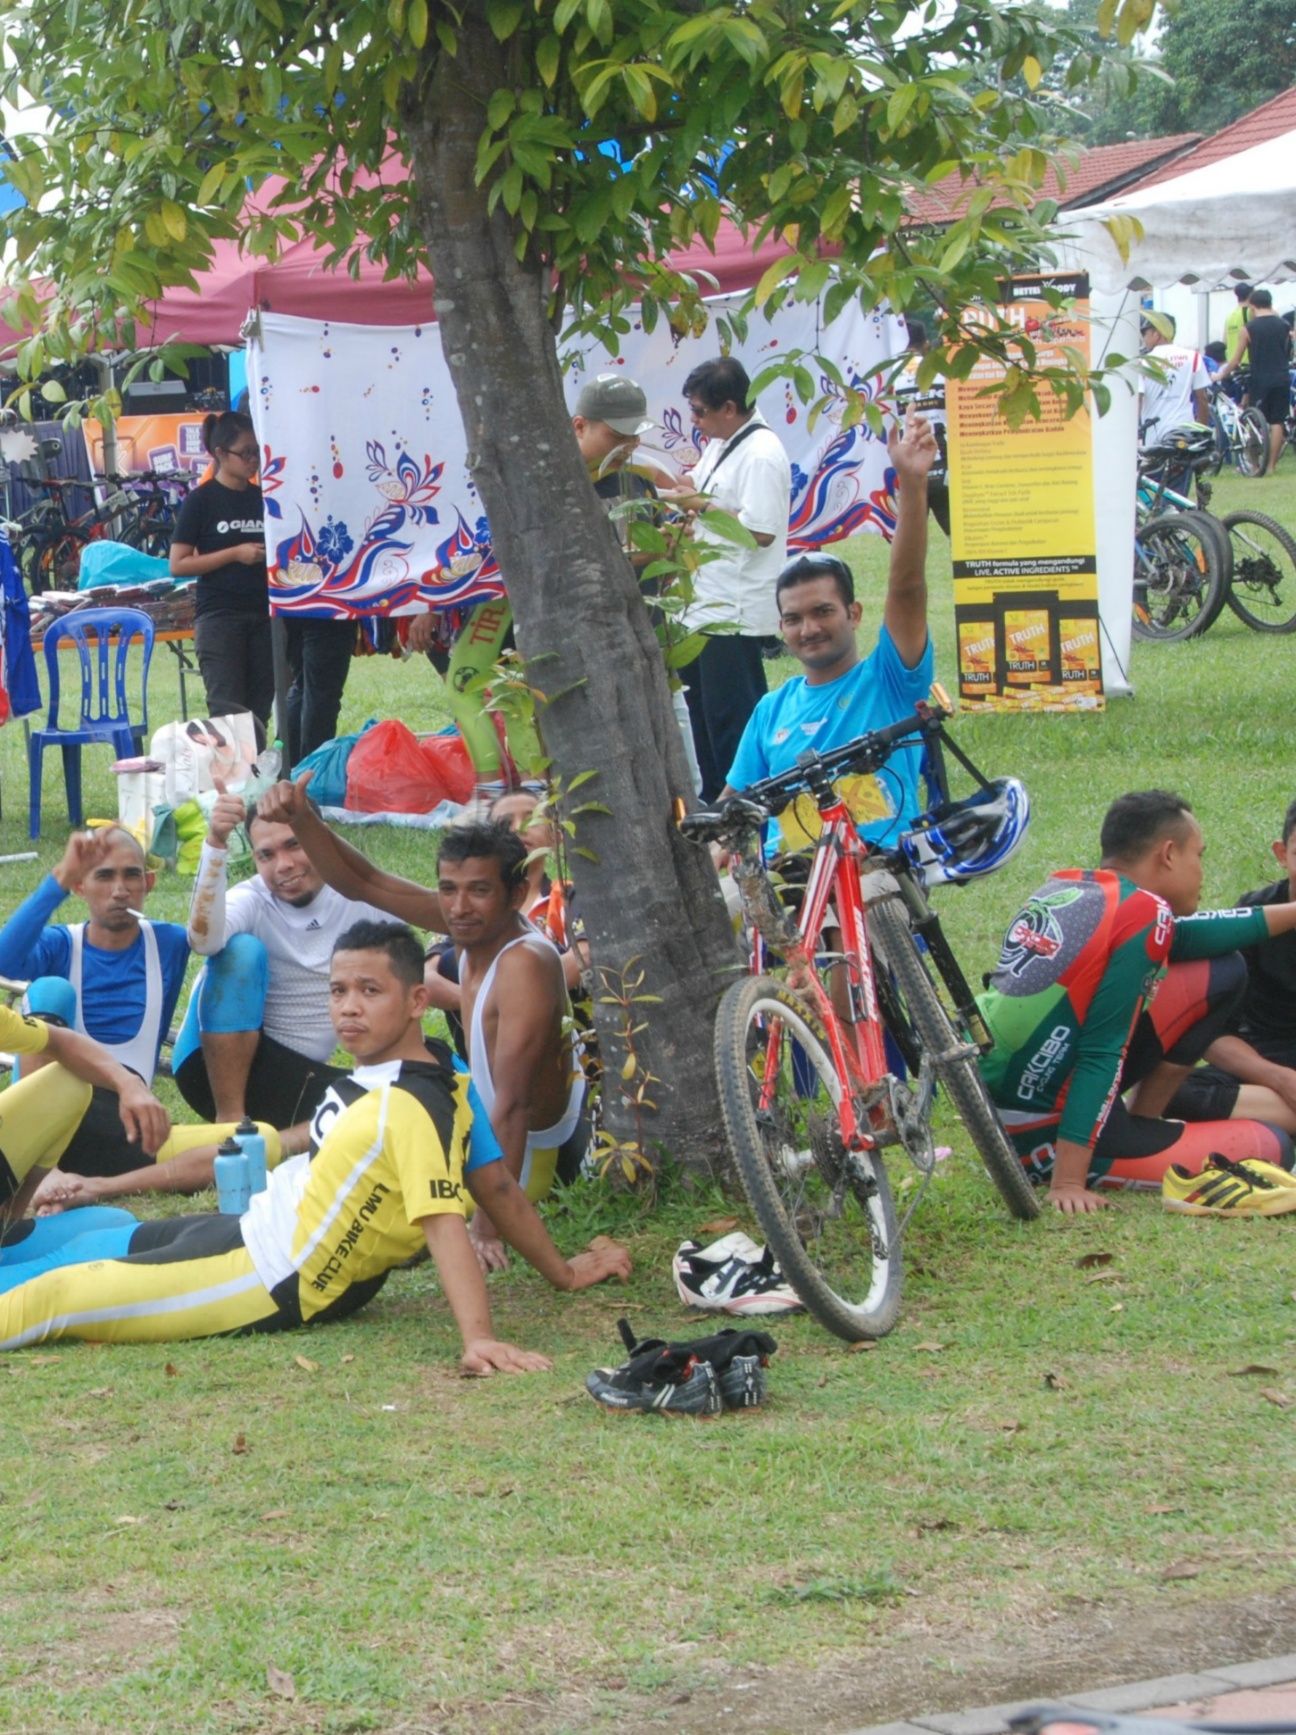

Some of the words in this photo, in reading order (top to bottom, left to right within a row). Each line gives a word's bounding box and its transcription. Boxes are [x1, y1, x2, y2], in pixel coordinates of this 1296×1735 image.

[993, 567, 1021, 576] ACTIVE
[1021, 565, 1071, 575] INGREDIENTS
[1009, 623, 1046, 645] TRUTH
[1008, 661, 1035, 670] TRUTH
[964, 673, 990, 682] TRUTH
[1017, 1025, 1071, 1101] CAKCIBO
[334, 1217, 365, 1259] BIKE
